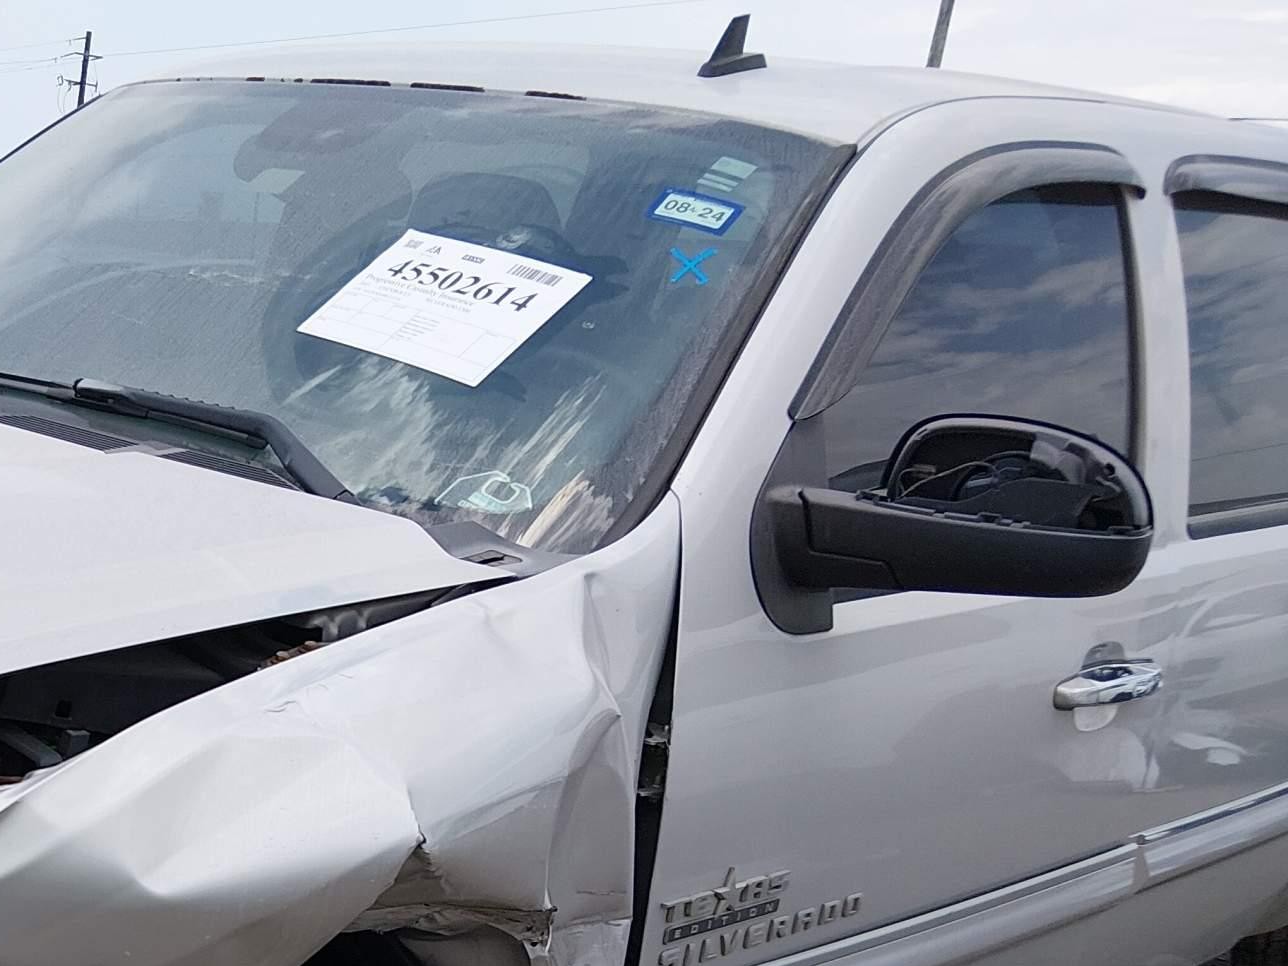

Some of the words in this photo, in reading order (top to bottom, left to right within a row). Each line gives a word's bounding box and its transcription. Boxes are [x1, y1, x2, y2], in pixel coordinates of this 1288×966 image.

[663, 199, 692, 214] 08
[697, 206, 727, 222] 24
[387, 259, 539, 312] 45502614
[661, 867, 792, 923] TEXAS
[670, 900, 779, 941] EDITION
